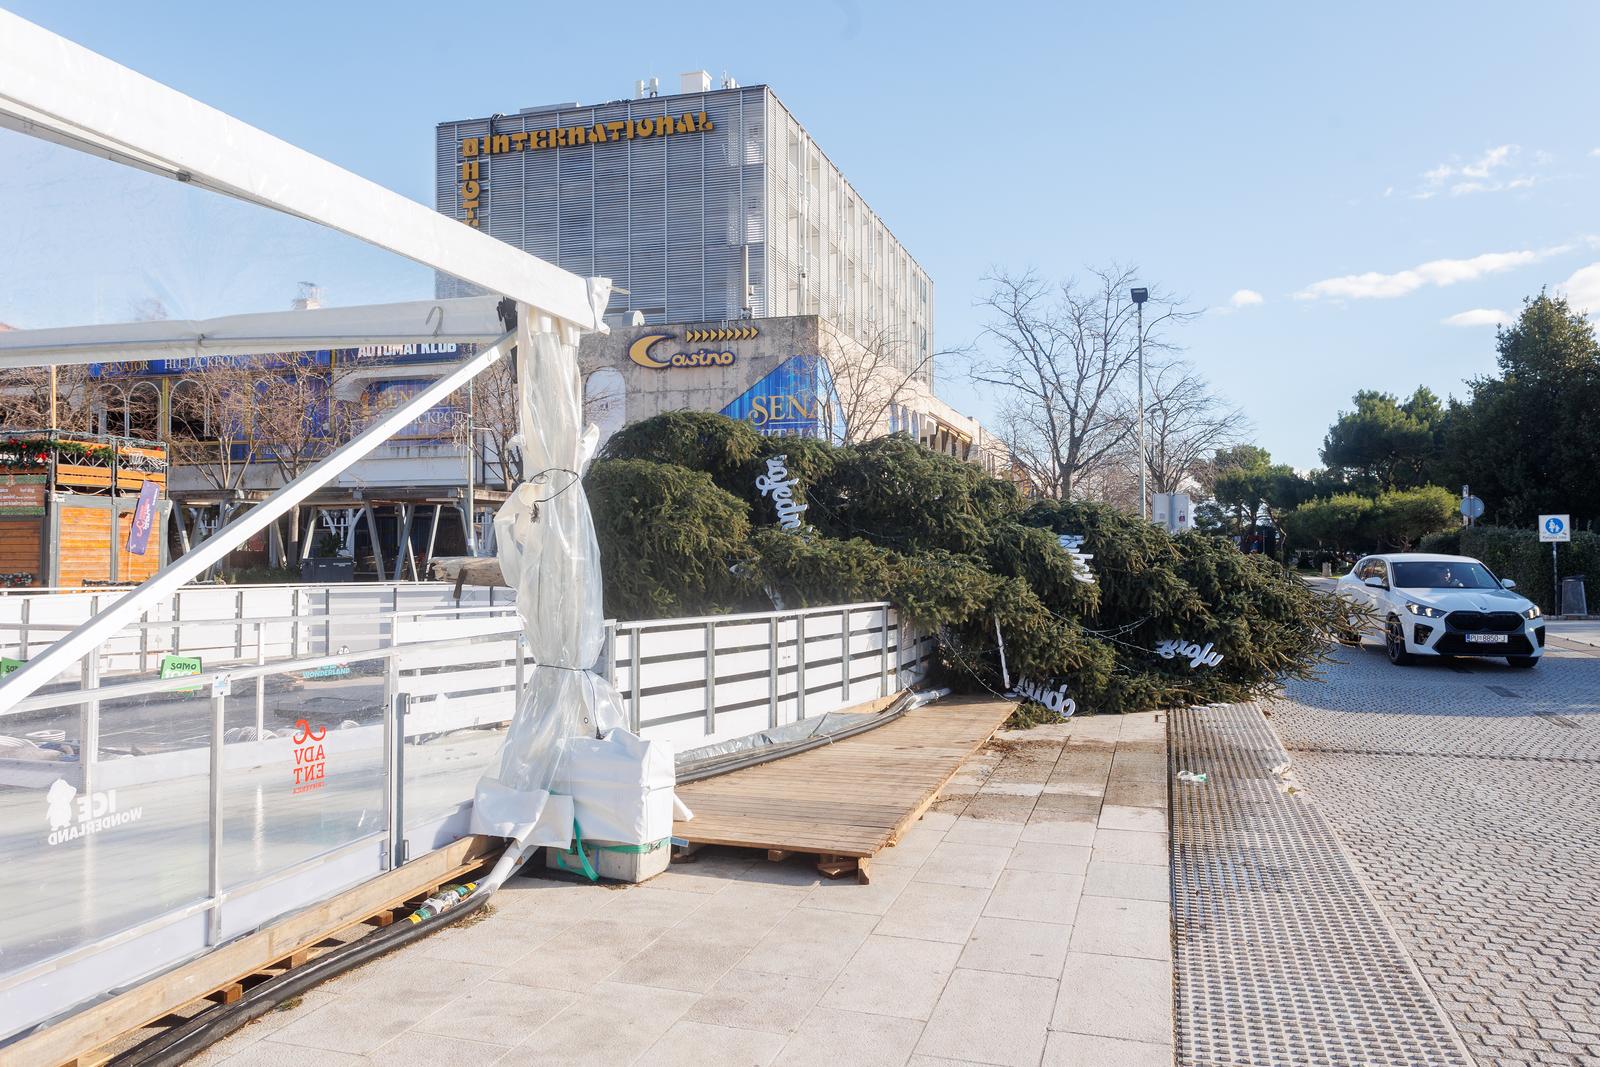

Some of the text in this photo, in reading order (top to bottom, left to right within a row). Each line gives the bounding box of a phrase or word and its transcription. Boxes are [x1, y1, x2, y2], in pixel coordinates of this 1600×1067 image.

[483, 111, 715, 155] INTERNATIONAL
[461, 160, 480, 228] HOT
[421, 343, 457, 354] KLUB
[628, 334, 736, 369] Casino
